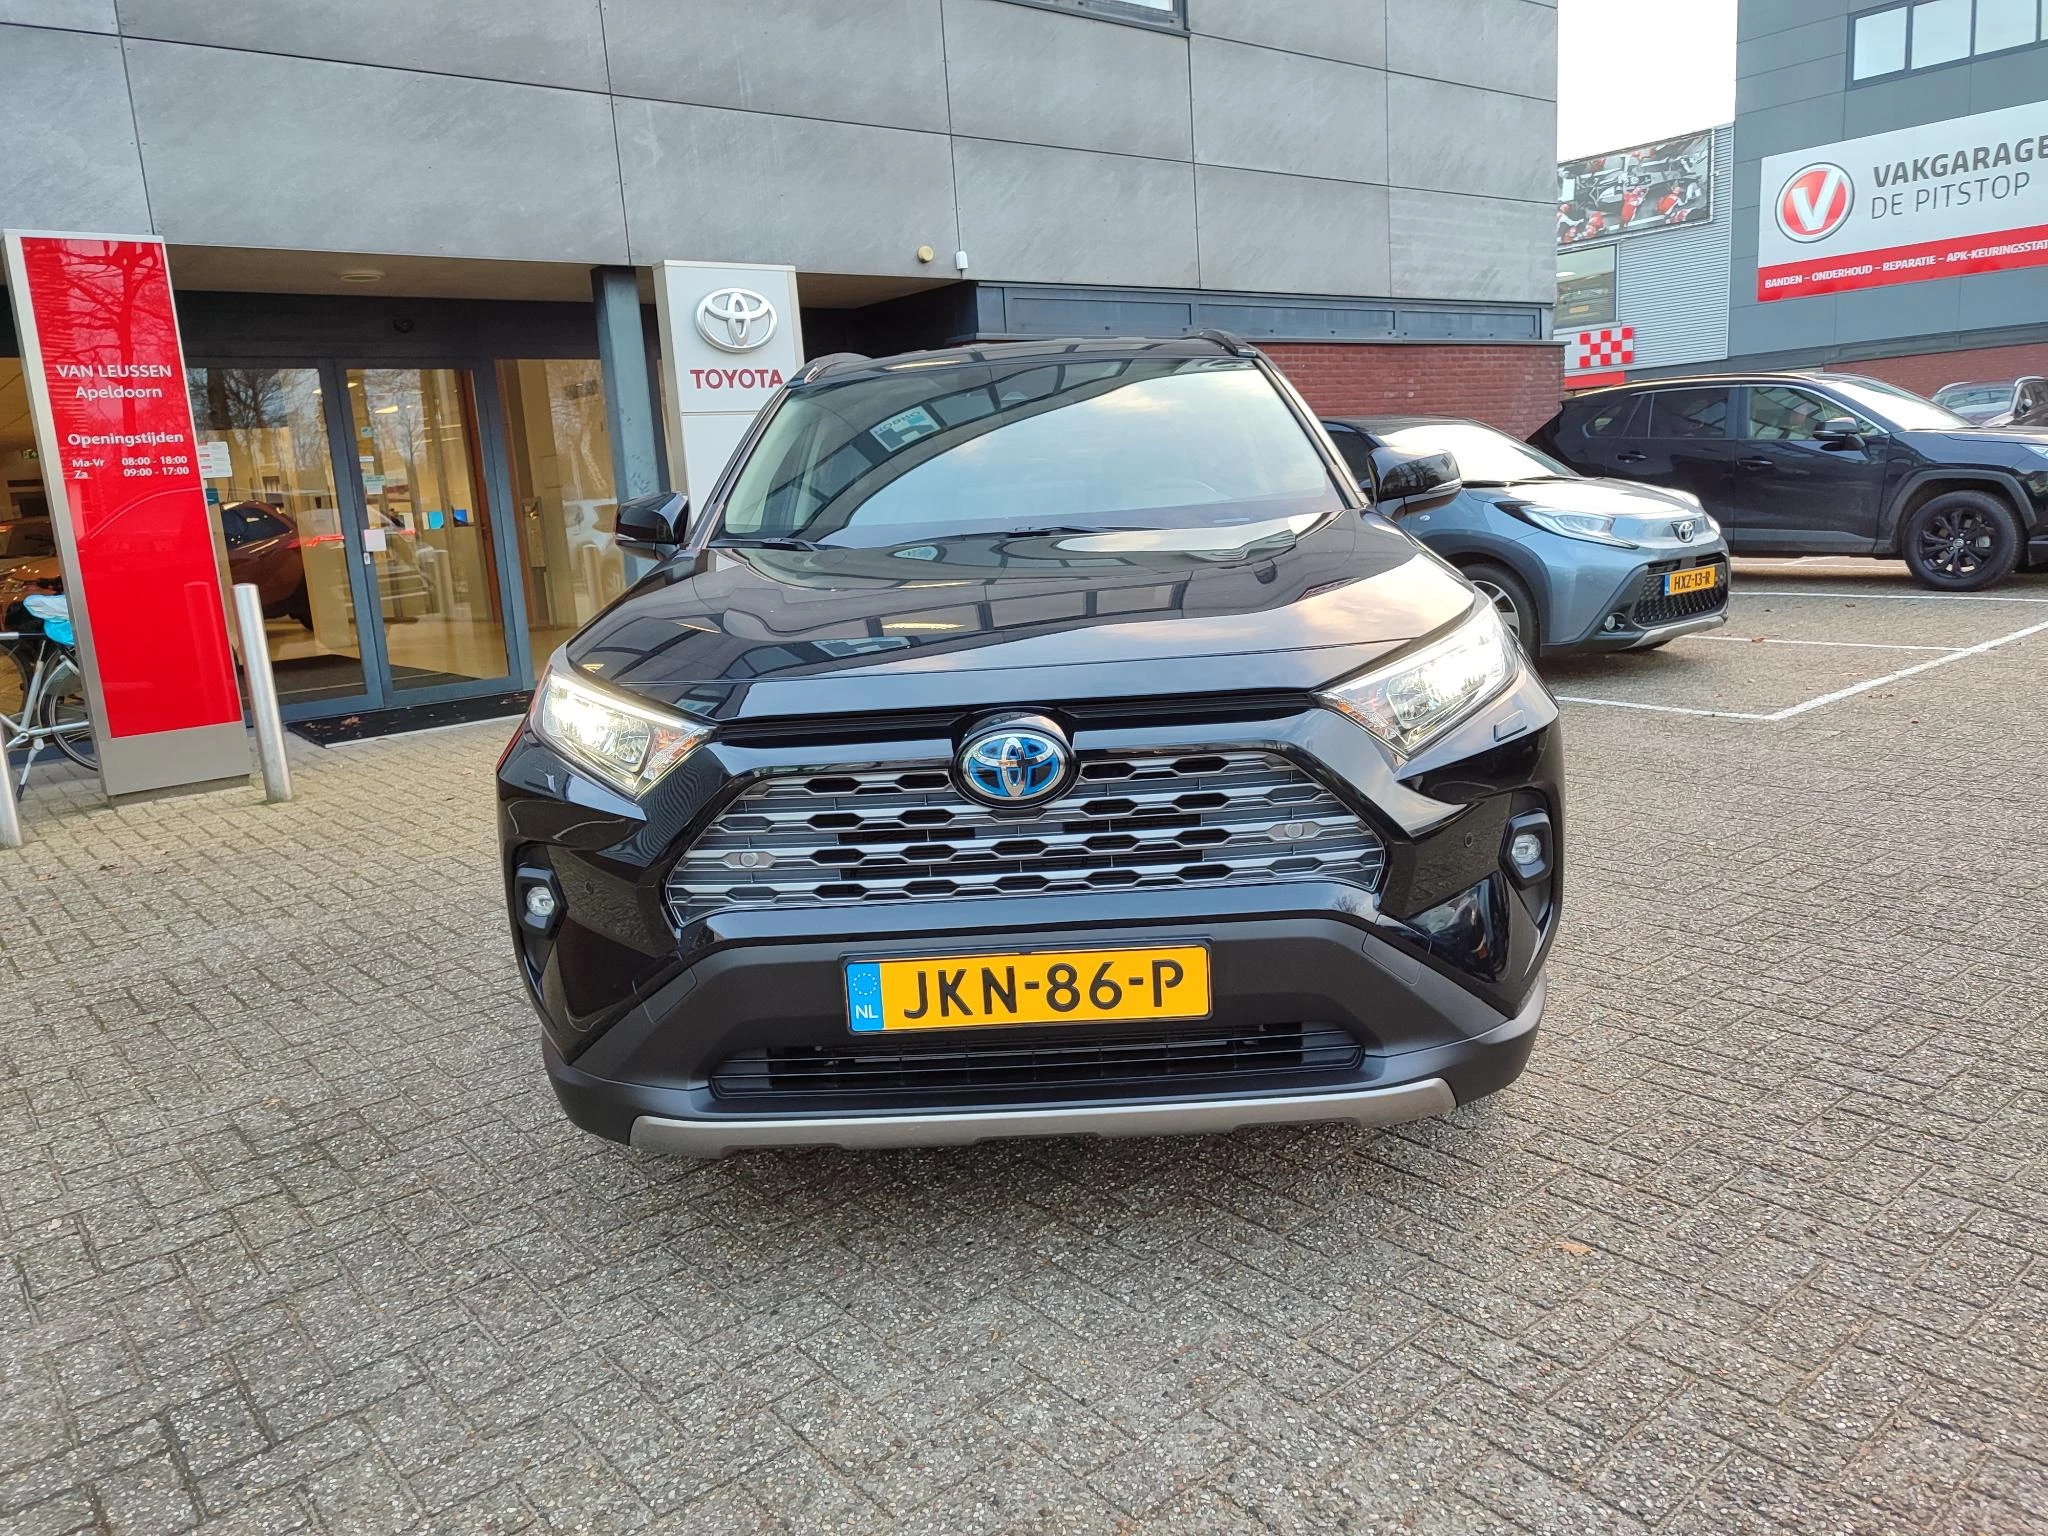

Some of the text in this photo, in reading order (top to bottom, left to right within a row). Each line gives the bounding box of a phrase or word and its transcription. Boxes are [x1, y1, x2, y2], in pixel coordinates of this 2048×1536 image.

[1873, 135, 2048, 188] VAKGARAGE
[1871, 171, 2030, 219] DE PITSTOP
[1765, 274, 1802, 288] BANDEN
[1812, 265, 1872, 282] ONDERHOUD
[1883, 255, 1936, 272] REPARATIE
[56, 364, 172, 378] VAN LEUSSEN
[690, 369, 783, 389] TOYOTA
[75, 387, 162, 401] Apeldoorn
[68, 433, 183, 447] Openingstijden
[72, 458, 105, 468] Ma-Vr
[121, 457, 150, 466] 08:00
[160, 456, 187, 465] 18:00
[74, 470, 88, 479] Za
[123, 468, 153, 477] 09:00
[162, 467, 189, 476] 17:00
[1674, 571, 1710, 590] HXZ-13-R
[903, 959, 1184, 1020] JKN-86-P
[855, 1003, 879, 1020] NL
